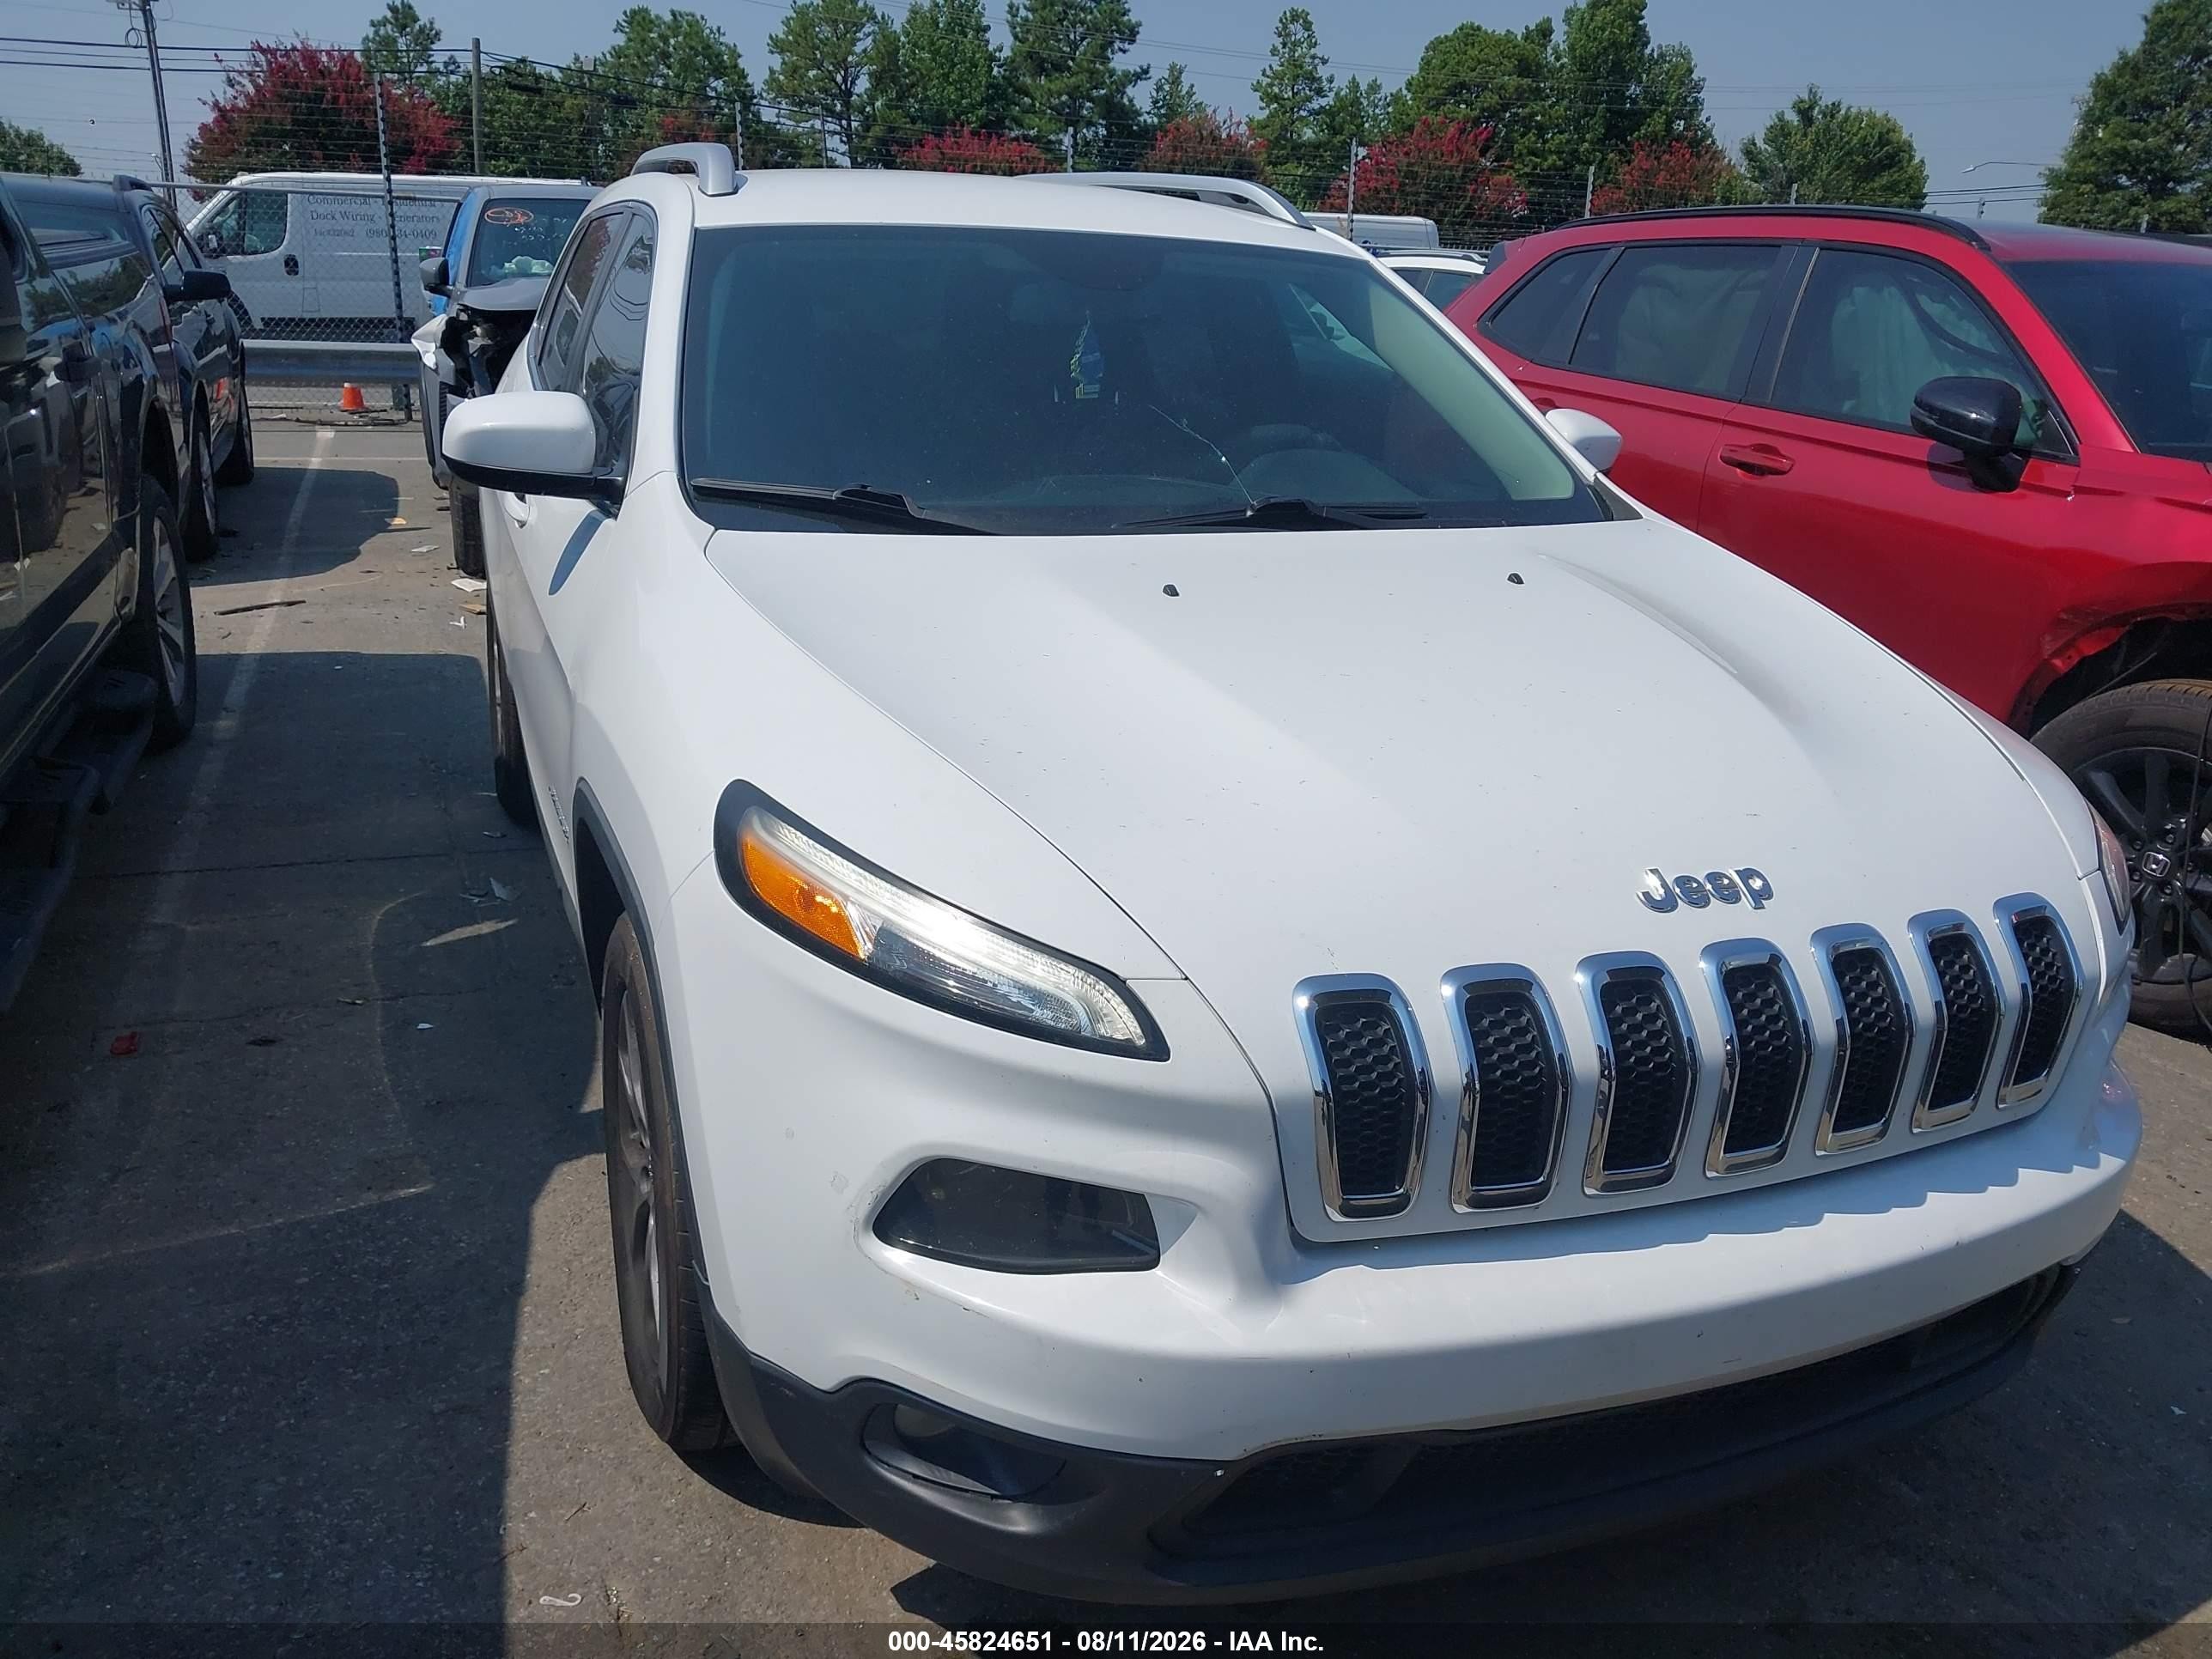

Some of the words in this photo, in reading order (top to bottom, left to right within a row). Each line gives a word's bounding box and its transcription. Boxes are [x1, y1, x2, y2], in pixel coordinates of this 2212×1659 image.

[307, 196, 371, 207] Commercial
[310, 210, 337, 221] Dock
[339, 210, 377, 223] Wiring
[394, 214, 441, 223] enerators
[1636, 866, 1774, 914] Jeep
